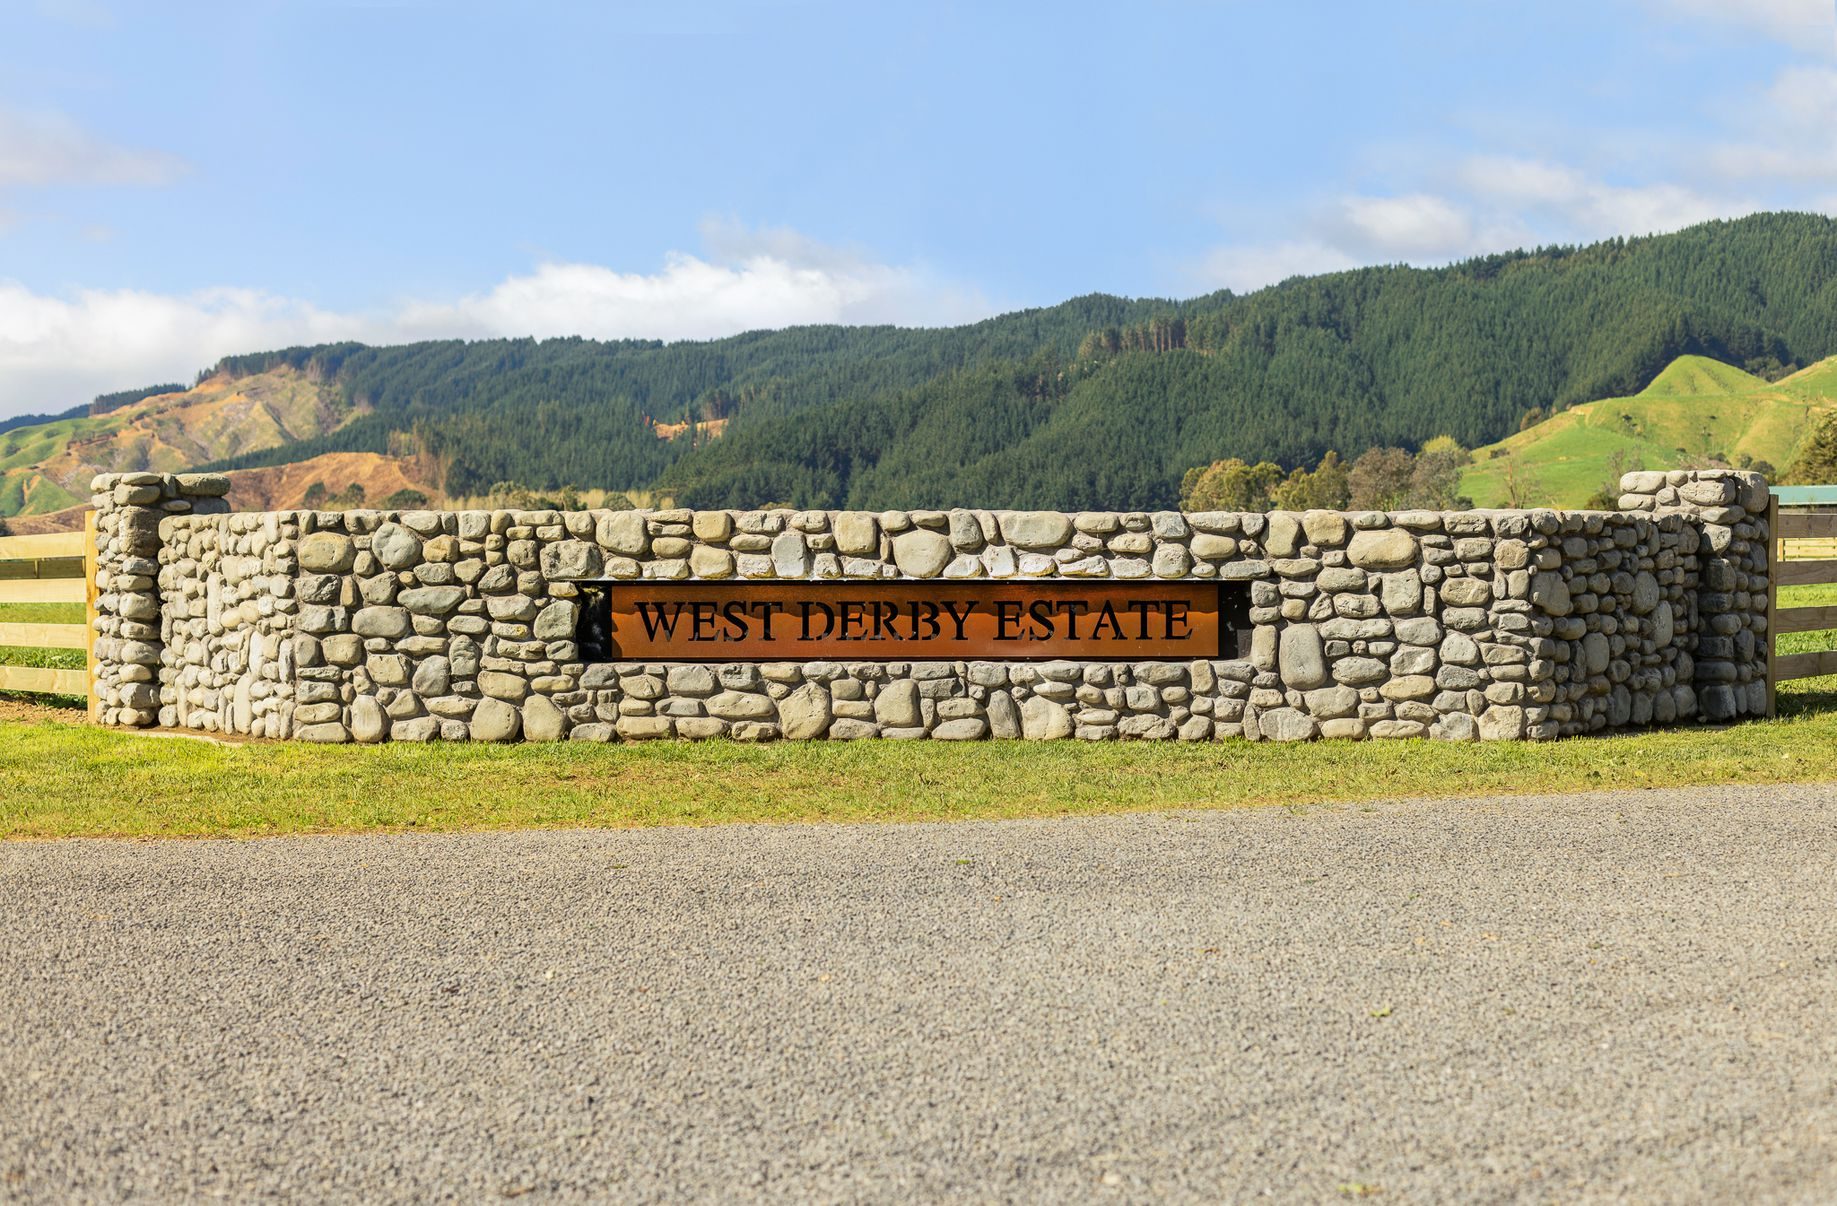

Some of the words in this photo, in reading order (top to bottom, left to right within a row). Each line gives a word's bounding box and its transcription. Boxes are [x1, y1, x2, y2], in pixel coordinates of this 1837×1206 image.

[634, 601, 783, 642] WEST
[795, 600, 979, 641] DERBY
[993, 600, 1193, 641] ESTATE
